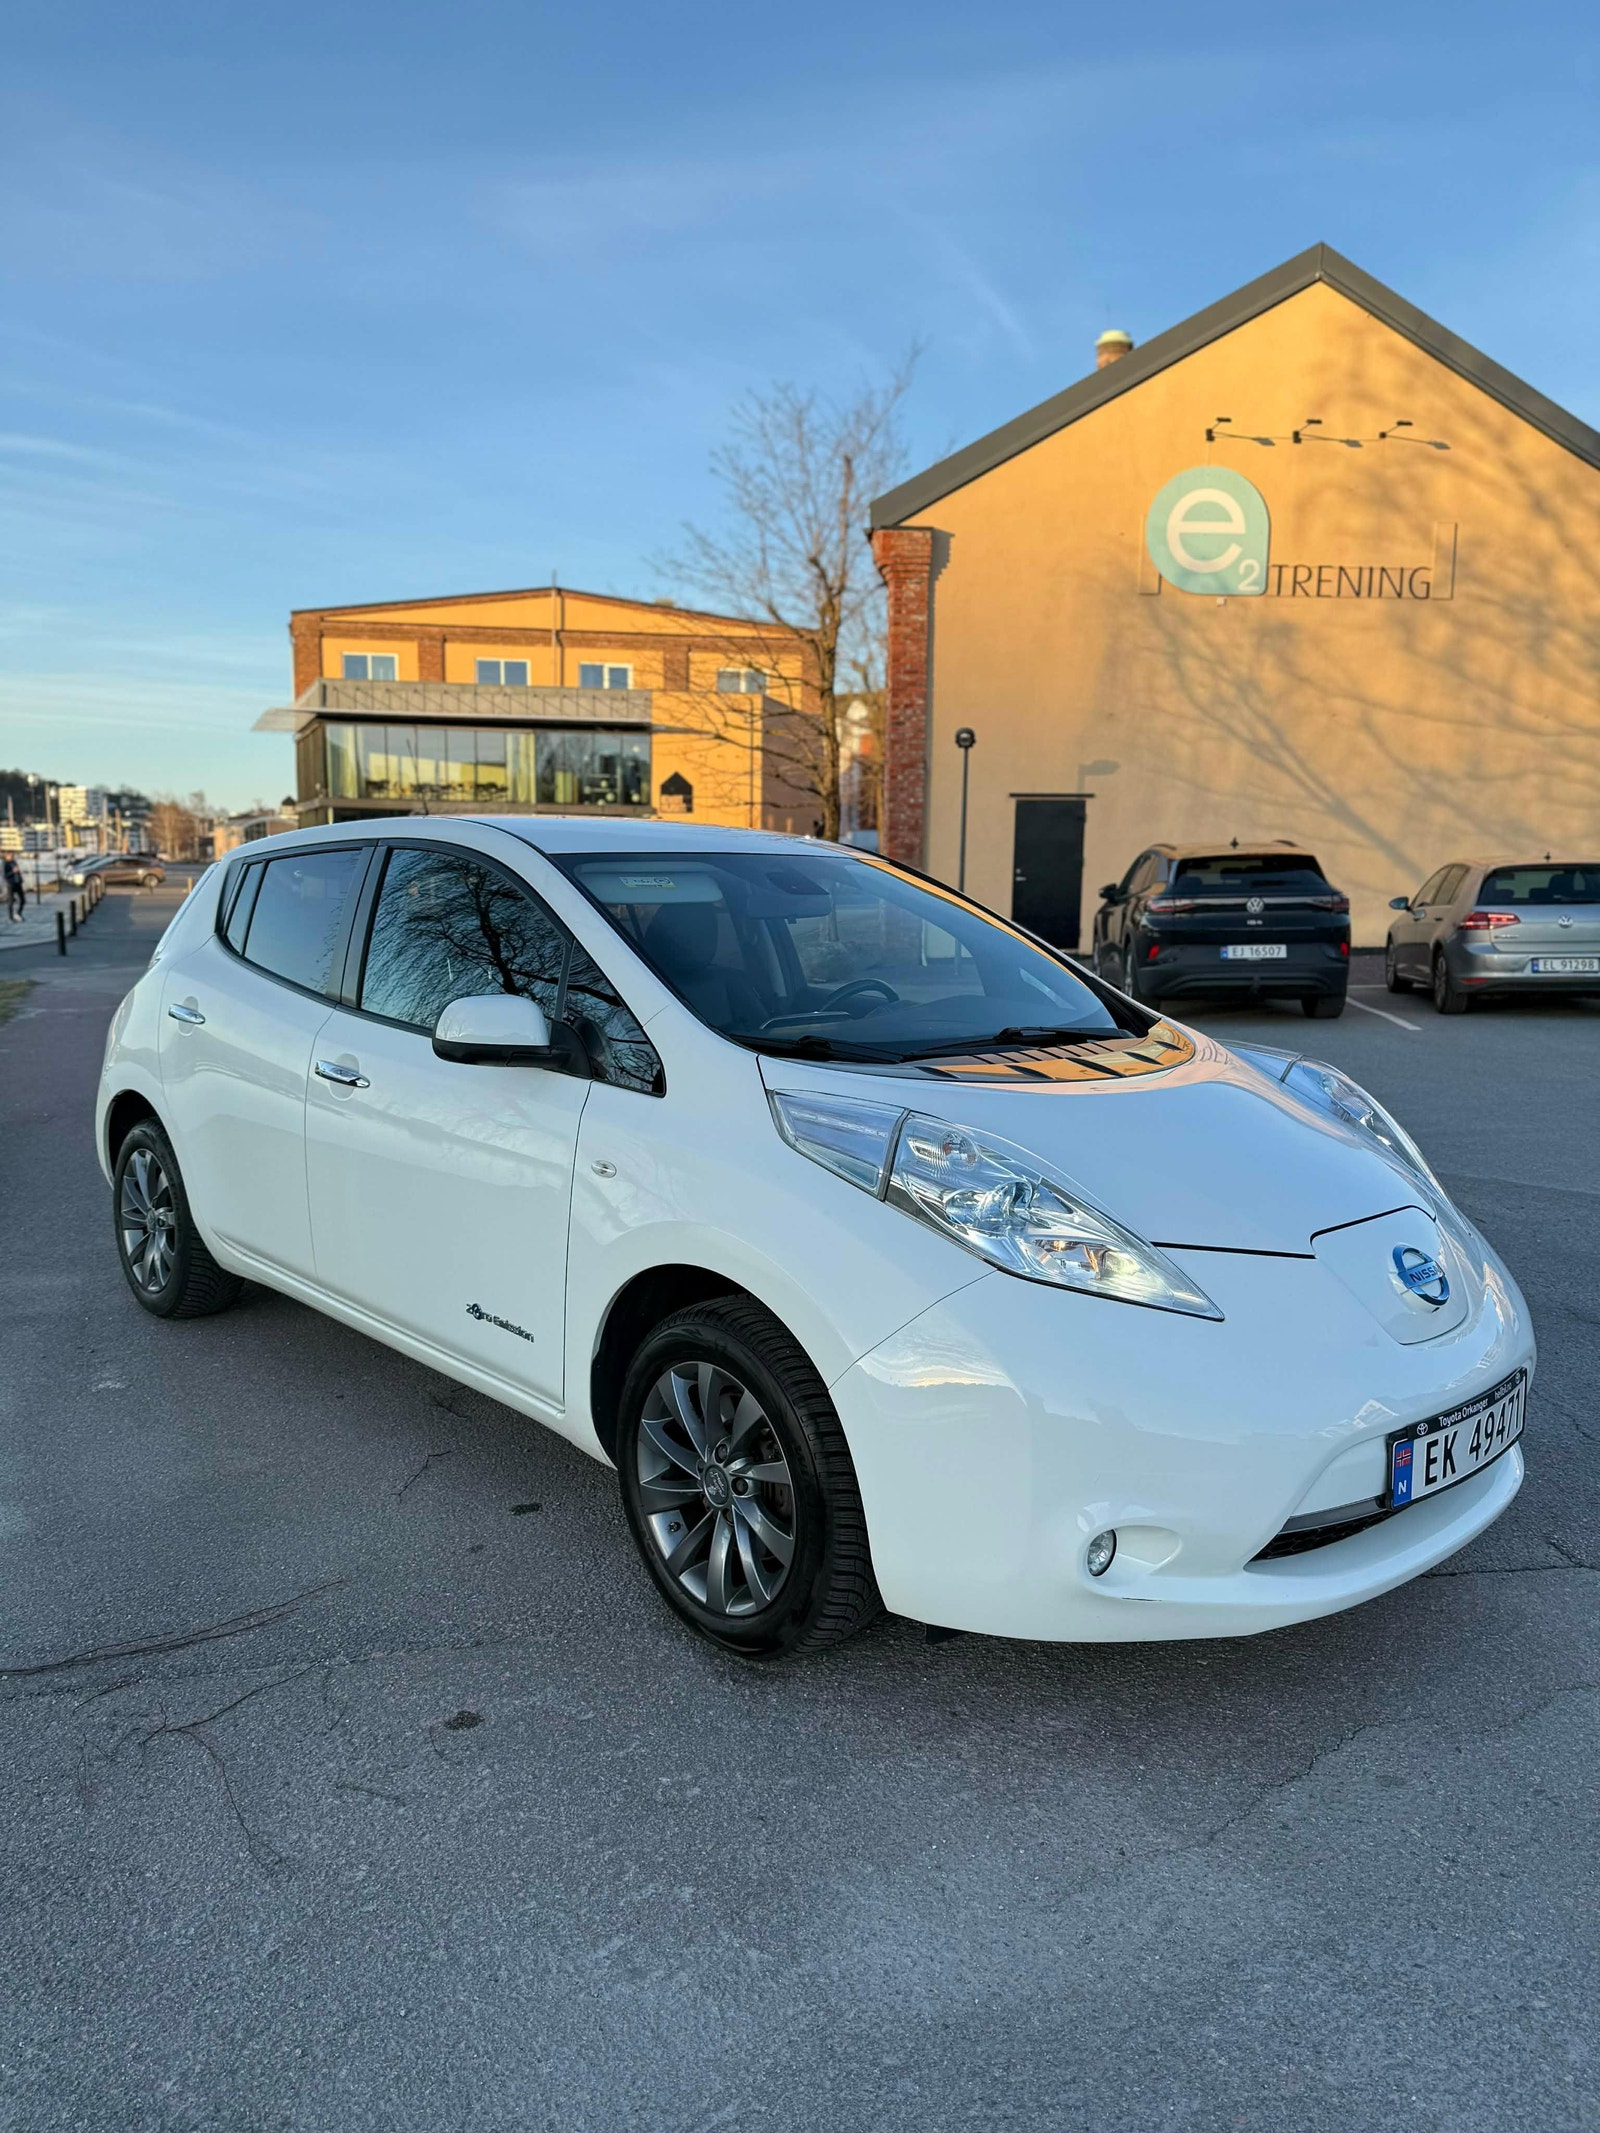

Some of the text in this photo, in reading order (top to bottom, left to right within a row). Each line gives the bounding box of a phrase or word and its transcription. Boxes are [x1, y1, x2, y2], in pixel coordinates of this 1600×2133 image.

[1271, 564, 1432, 599] TRENING
[1543, 960, 1594, 970] EL 91298
[1409, 1265, 1441, 1283] NISS
[1438, 1411, 1462, 1427] Toyota
[1462, 1398, 1489, 1418] Orkanger
[1425, 1389, 1520, 1486] EK 49471
[1398, 1480, 1407, 1495] N
